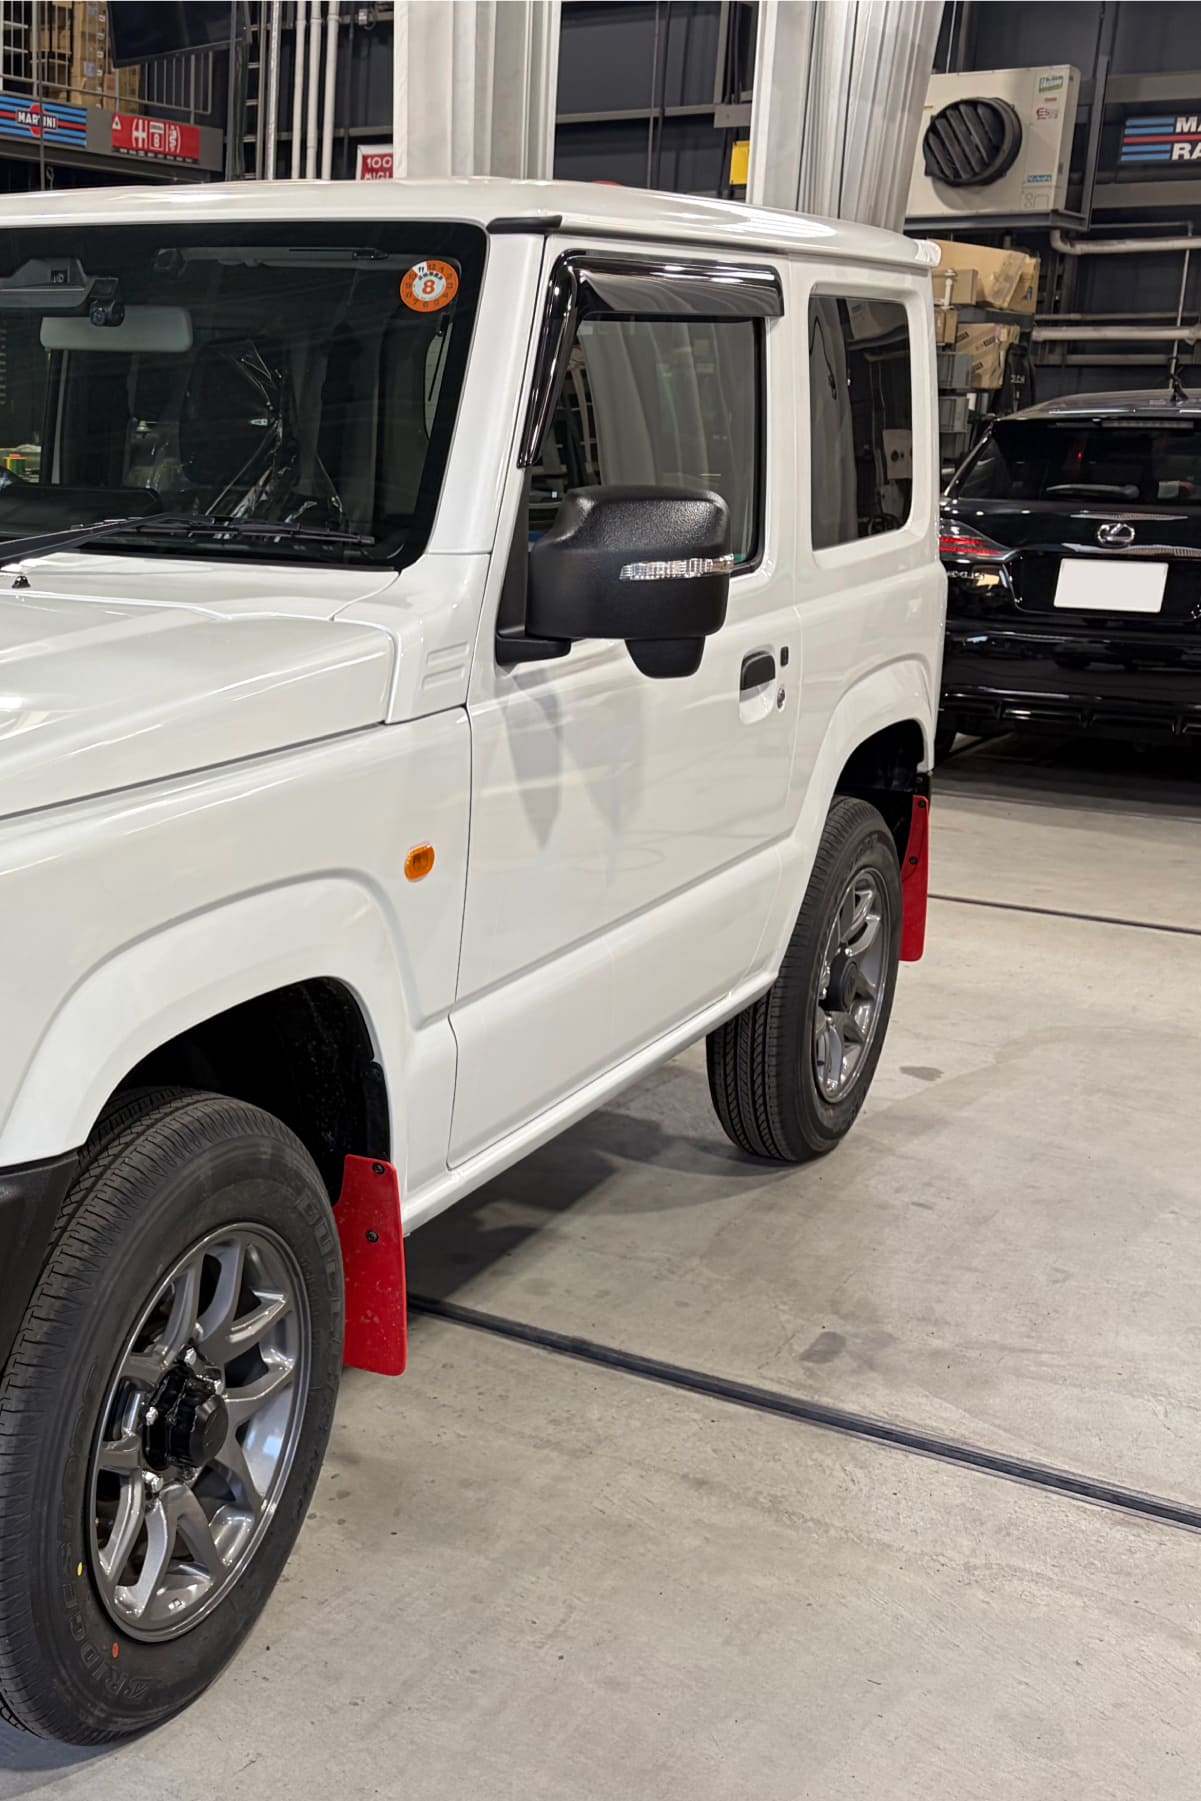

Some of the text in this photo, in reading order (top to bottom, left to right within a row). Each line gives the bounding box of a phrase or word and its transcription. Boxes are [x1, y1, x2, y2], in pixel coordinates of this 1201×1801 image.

[1175, 116, 1201, 133] M
[366, 156, 392, 169] 100
[422, 279, 436, 295] 8
